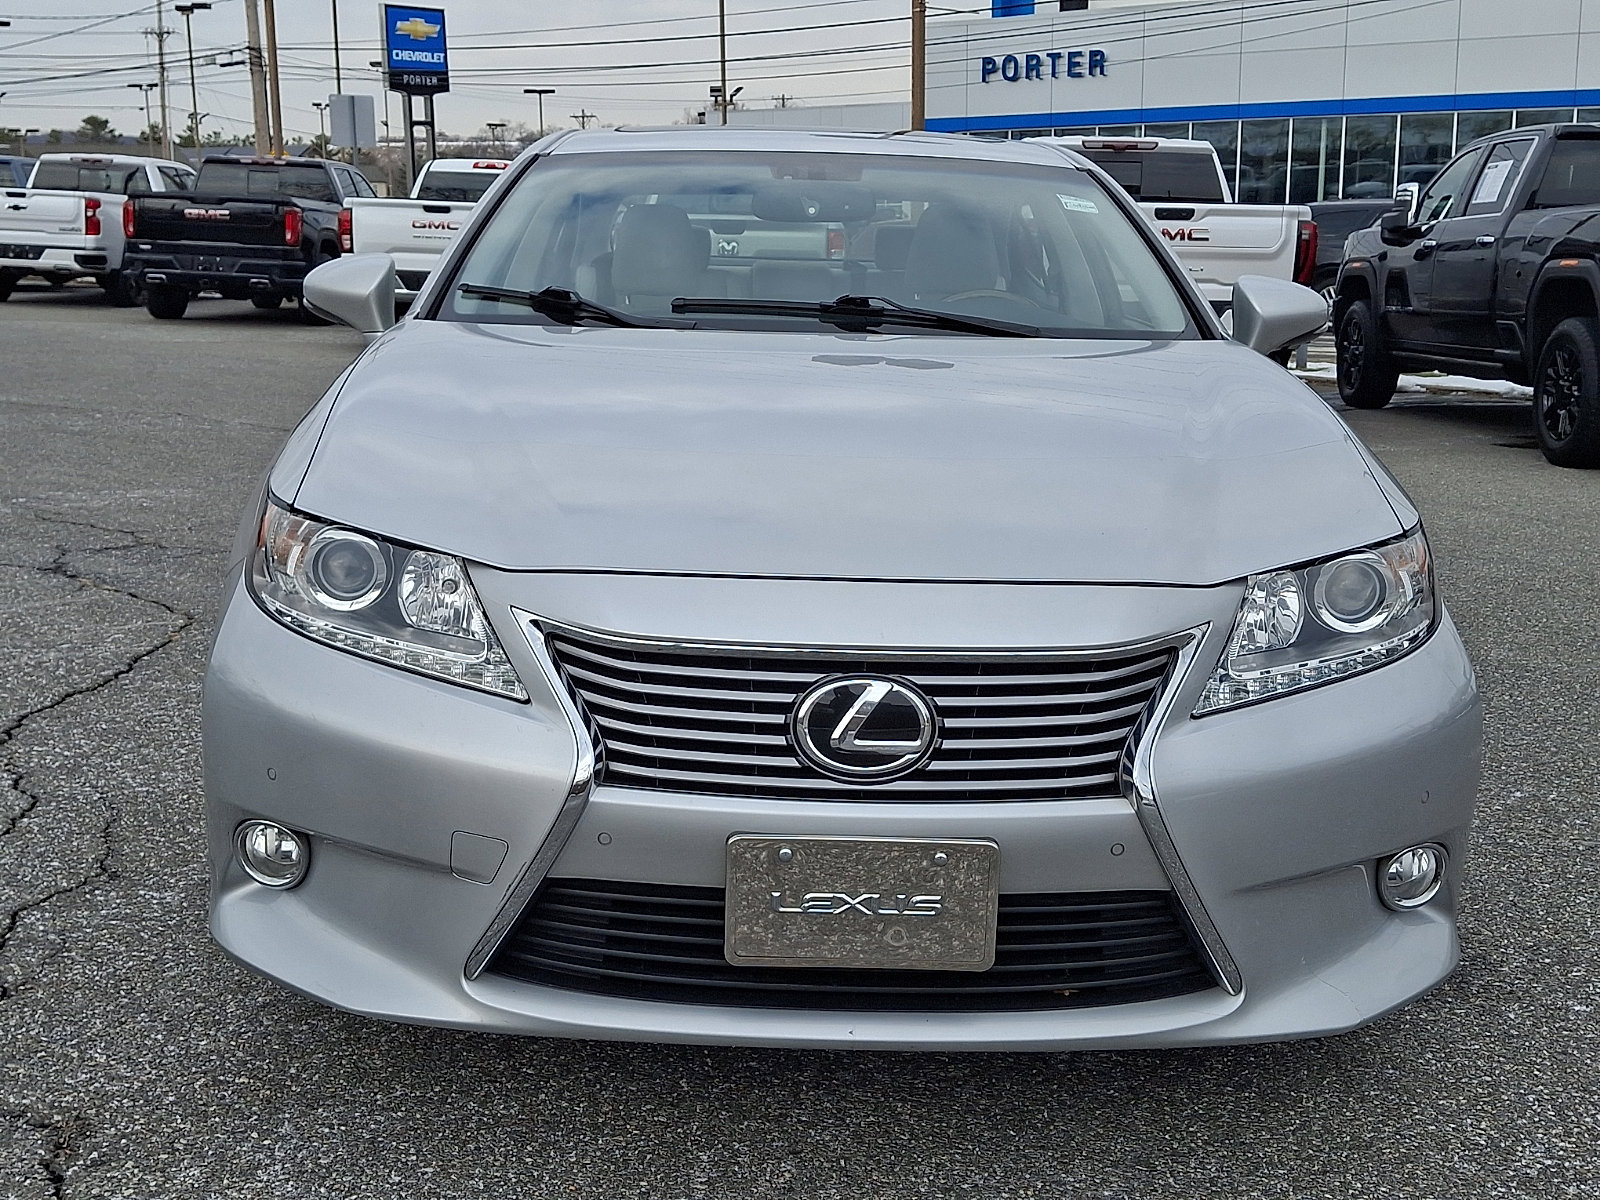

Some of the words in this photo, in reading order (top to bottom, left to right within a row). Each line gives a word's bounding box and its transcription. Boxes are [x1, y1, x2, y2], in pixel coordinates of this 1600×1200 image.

[392, 49, 445, 63] CHEVROLET
[981, 49, 1107, 83] PORTER
[402, 74, 438, 86] PORTER
[183, 208, 231, 220] GMC
[412, 220, 462, 231] GMC
[1160, 227, 1210, 242] MC
[770, 891, 943, 916] LEXUS
